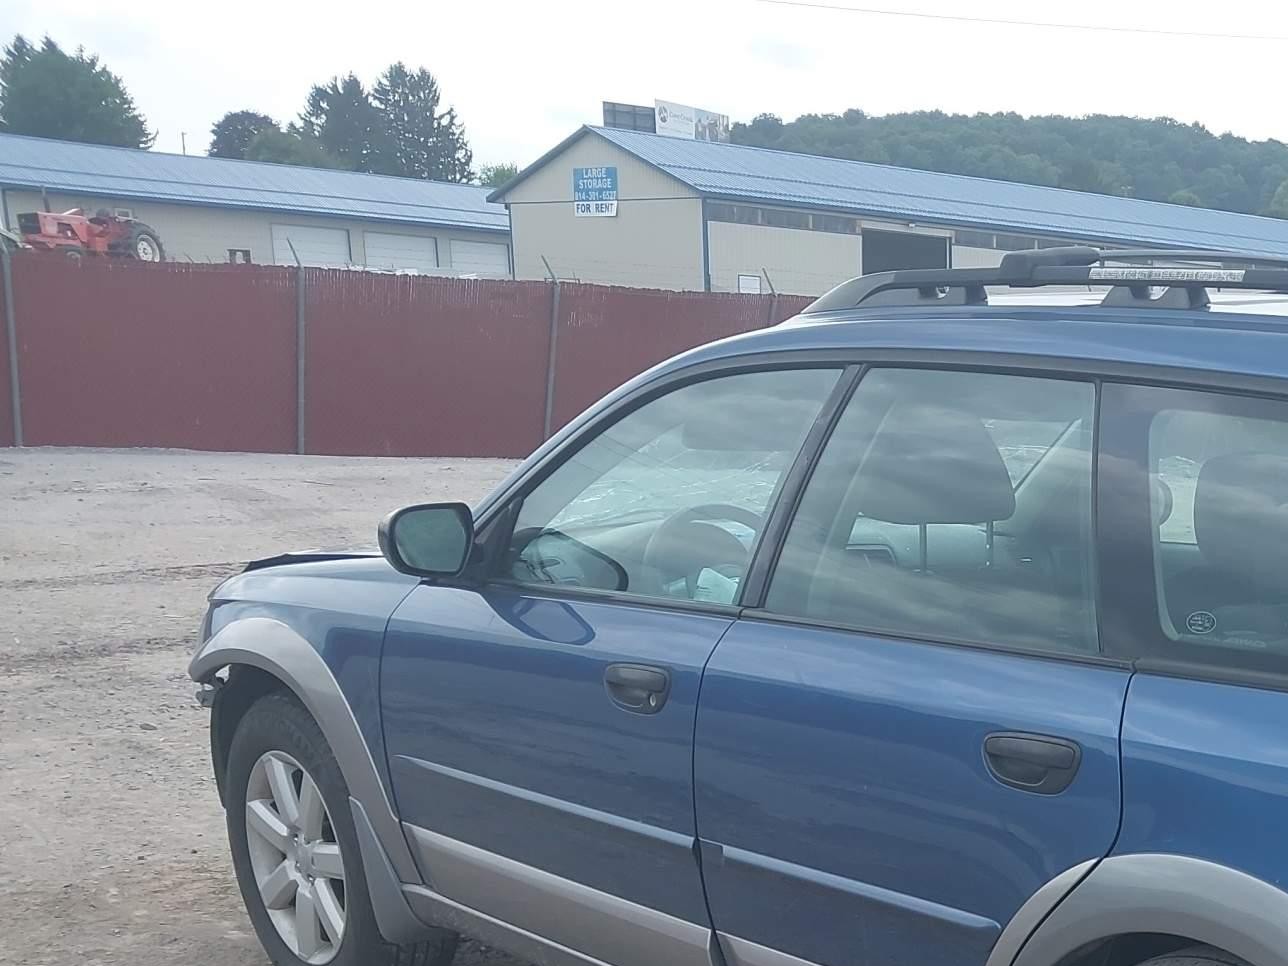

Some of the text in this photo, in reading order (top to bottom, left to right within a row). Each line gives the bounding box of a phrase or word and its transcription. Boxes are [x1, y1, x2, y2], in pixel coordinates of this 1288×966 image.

[583, 168, 607, 178] LARGE
[579, 178, 612, 189] STORAGE
[575, 203, 615, 213] FOR RENT
